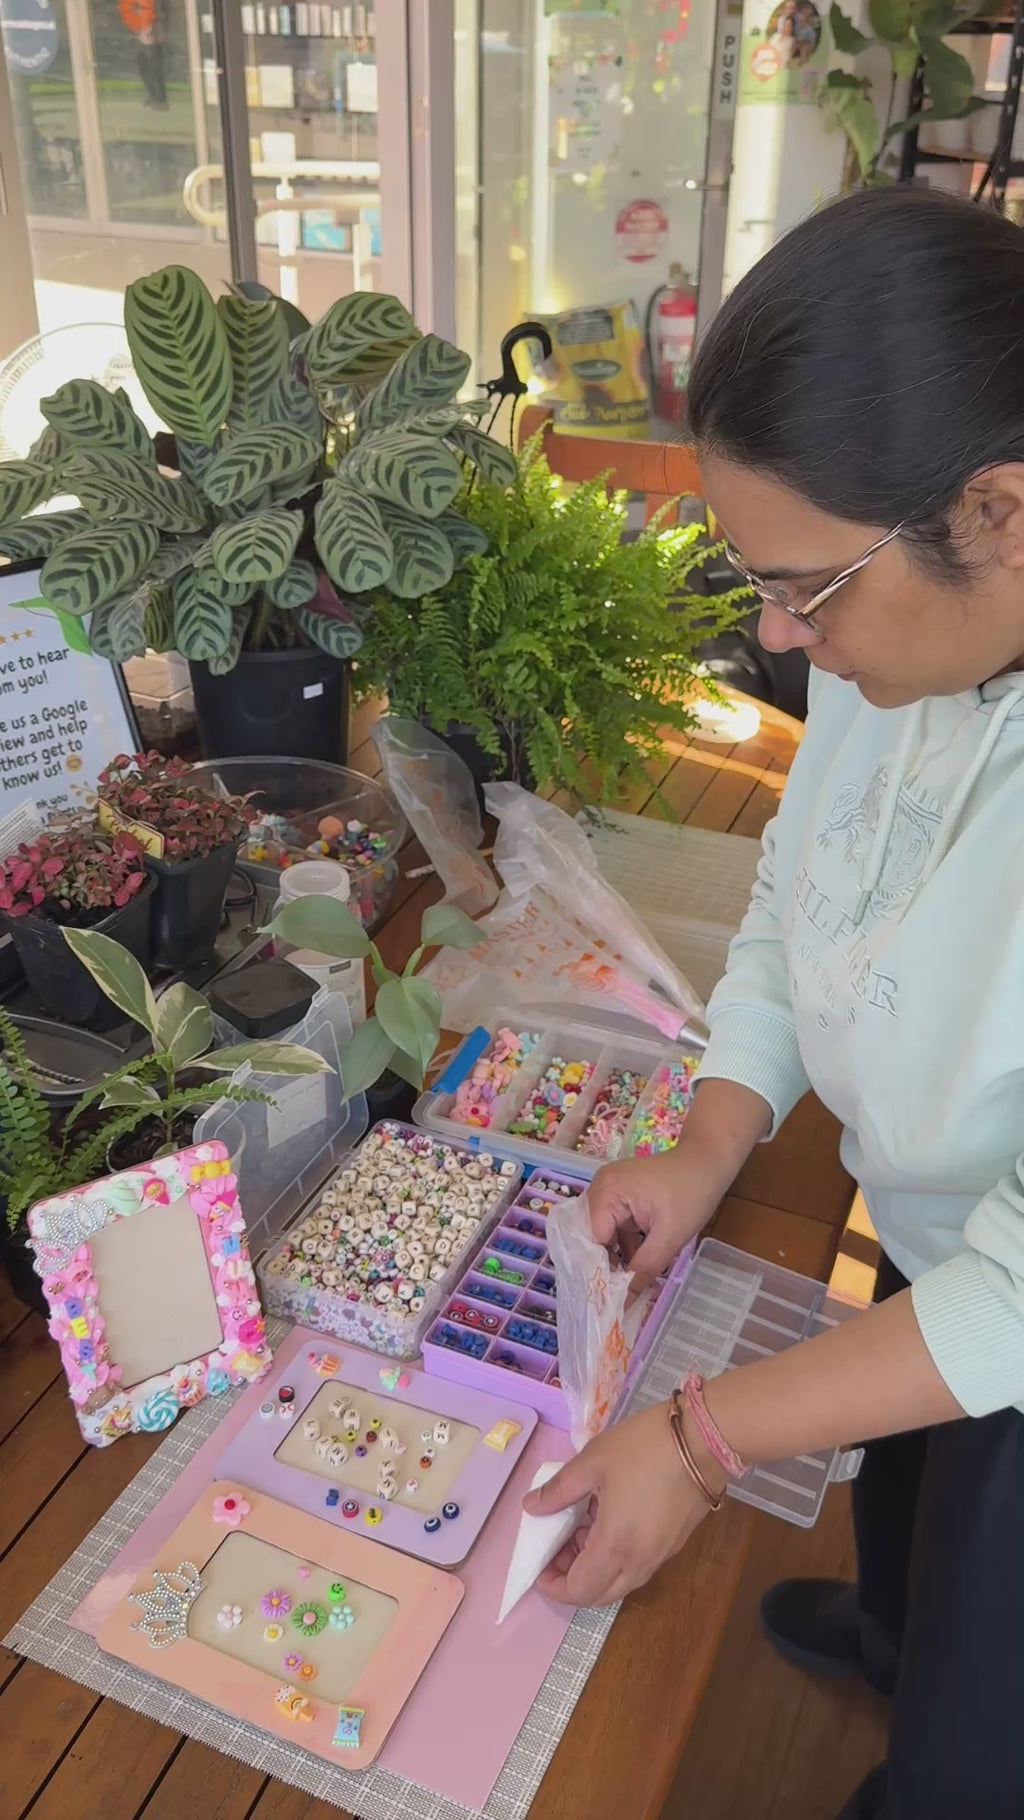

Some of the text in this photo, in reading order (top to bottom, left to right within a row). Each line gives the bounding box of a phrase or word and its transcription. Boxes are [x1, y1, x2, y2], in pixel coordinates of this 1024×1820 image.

[720, 35, 736, 105] PUSH
[18, 656, 35, 670] to
[37, 648, 70, 665] hear
[18, 669, 49, 694] you!
[11, 716, 26, 730] us
[29, 713, 39, 725] a
[41, 700, 88, 721] Google
[29, 724, 55, 744] and
[57, 720, 88, 735] help
[0, 739, 83, 772] thers get to
[2, 761, 63, 791] know us!
